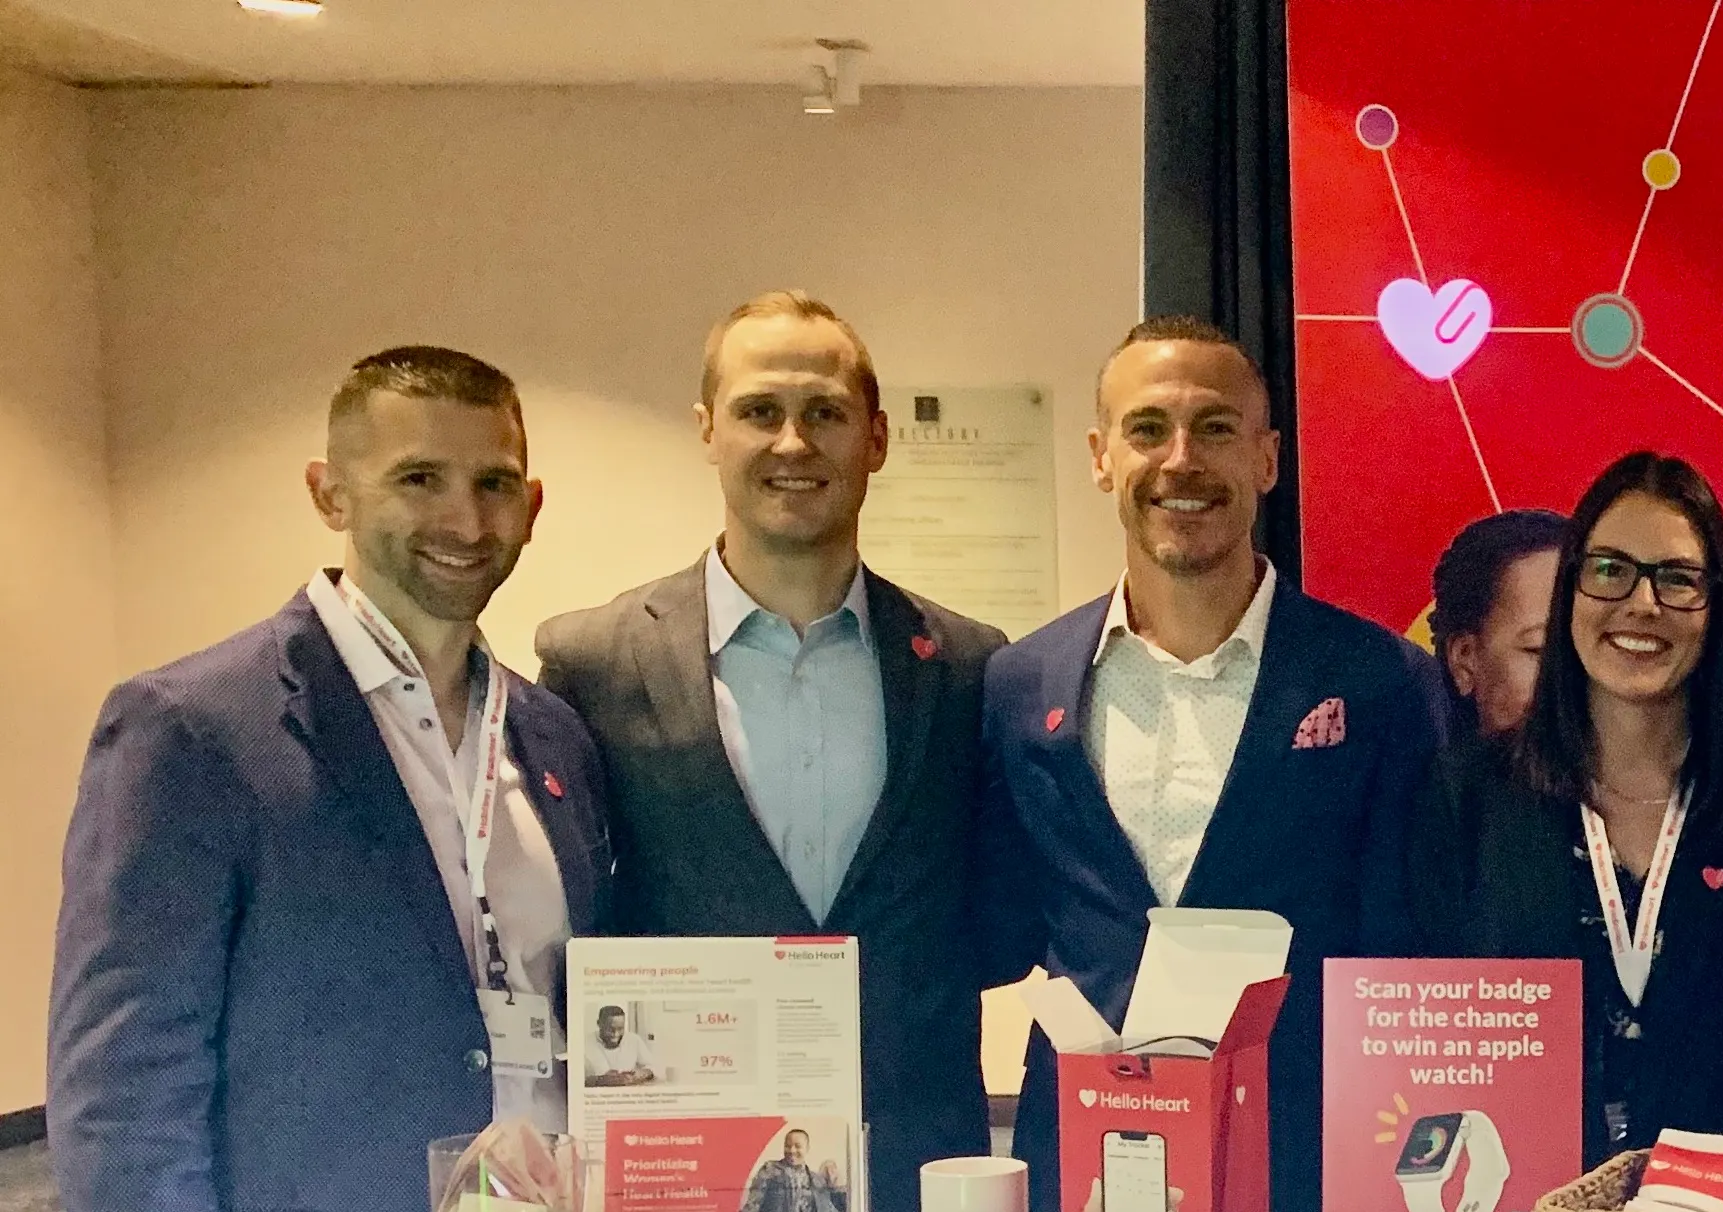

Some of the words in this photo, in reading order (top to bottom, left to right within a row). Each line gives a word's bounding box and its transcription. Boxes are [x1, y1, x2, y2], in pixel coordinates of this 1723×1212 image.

[788, 950, 814, 960] Hello
[815, 951, 845, 960] Heart
[583, 966, 657, 977] Empowering
[660, 966, 699, 976] people
[1354, 977, 1411, 1001] Scan
[1417, 981, 1474, 1001] your
[1478, 977, 1552, 1004] badge
[1366, 1006, 1403, 1029] for
[1408, 1006, 1448, 1029] the
[1453, 1006, 1539, 1029] chance
[1362, 1037, 1388, 1057] to
[1392, 1035, 1437, 1057] win
[1442, 1040, 1472, 1057] an
[1477, 1034, 1545, 1062] apple
[700, 1055, 734, 1068] 97%
[1409, 1063, 1494, 1086] watch!
[1100, 1091, 1141, 1110] Hello
[1142, 1093, 1191, 1113] Heart
[623, 1159, 698, 1172] Prioritizing
